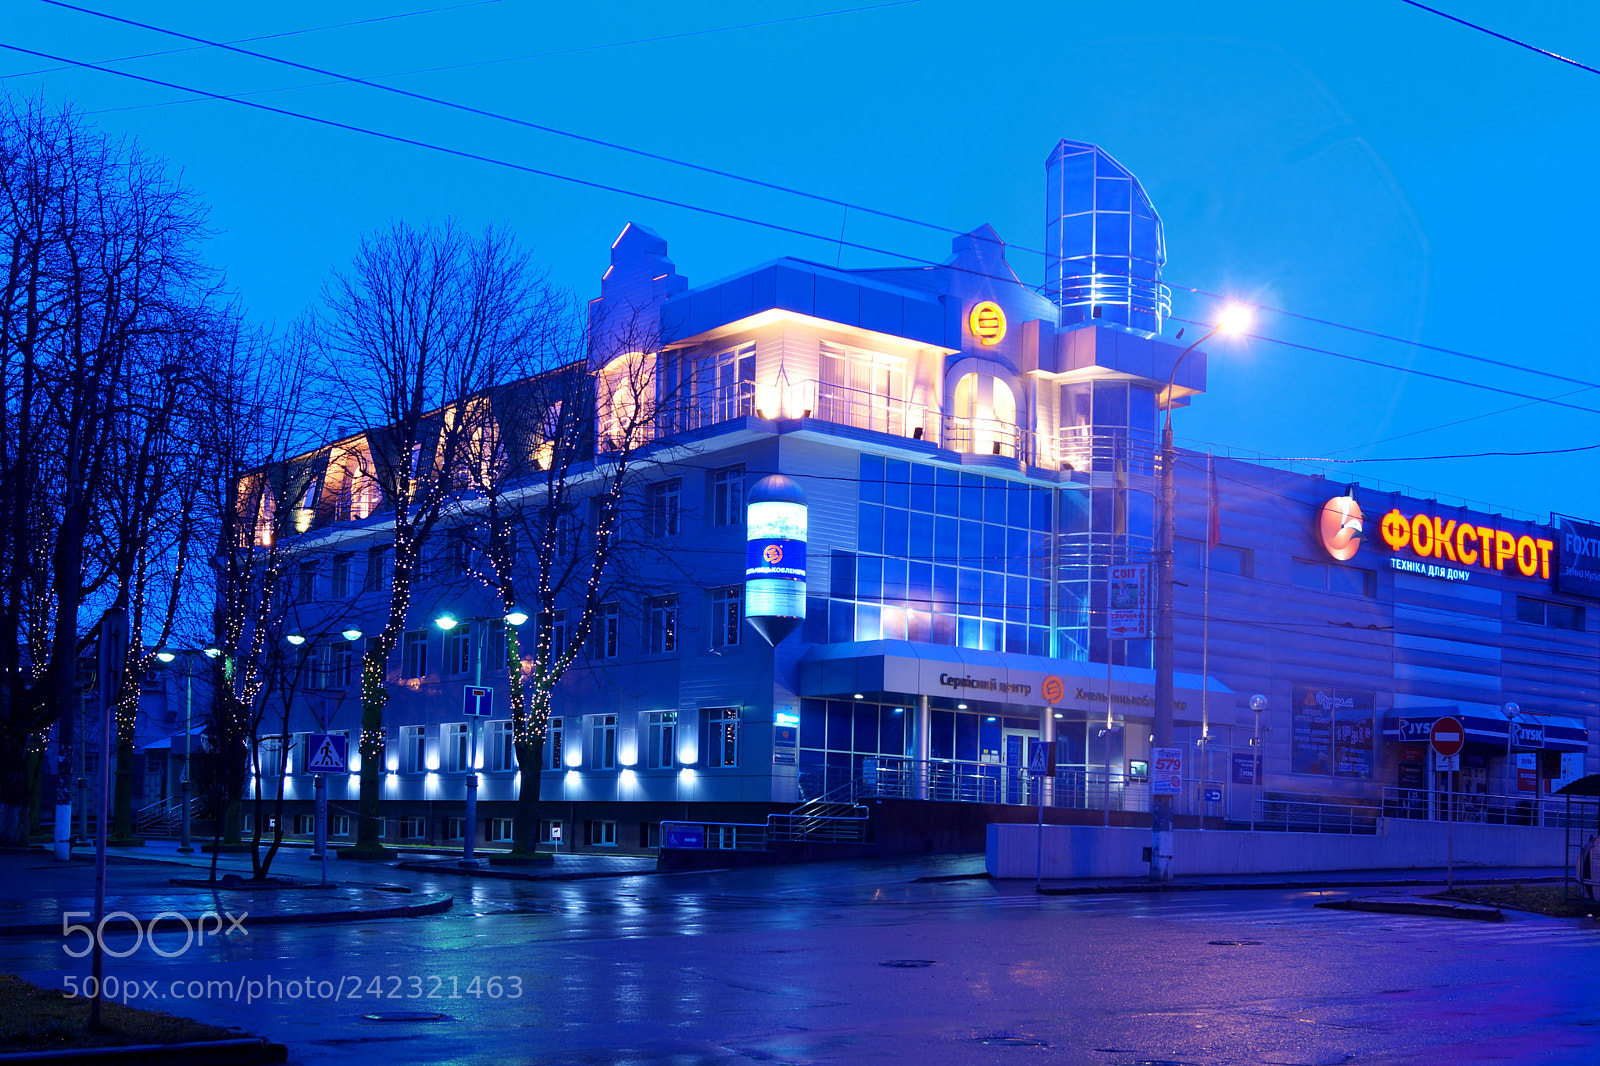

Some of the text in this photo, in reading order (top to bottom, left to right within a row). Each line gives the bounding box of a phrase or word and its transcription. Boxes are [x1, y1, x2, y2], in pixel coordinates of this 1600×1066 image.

[1381, 508, 1553, 579] ФОКСТРОТ
[1112, 569, 1136, 579] СВІТ
[1391, 558, 1470, 581] ТЕХНІКА ДЛЯ ДОМУ
[939, 673, 1031, 697] Сервісний центр
[1519, 729, 1542, 741] JYSK
[1155, 758, 1180, 770] 579
